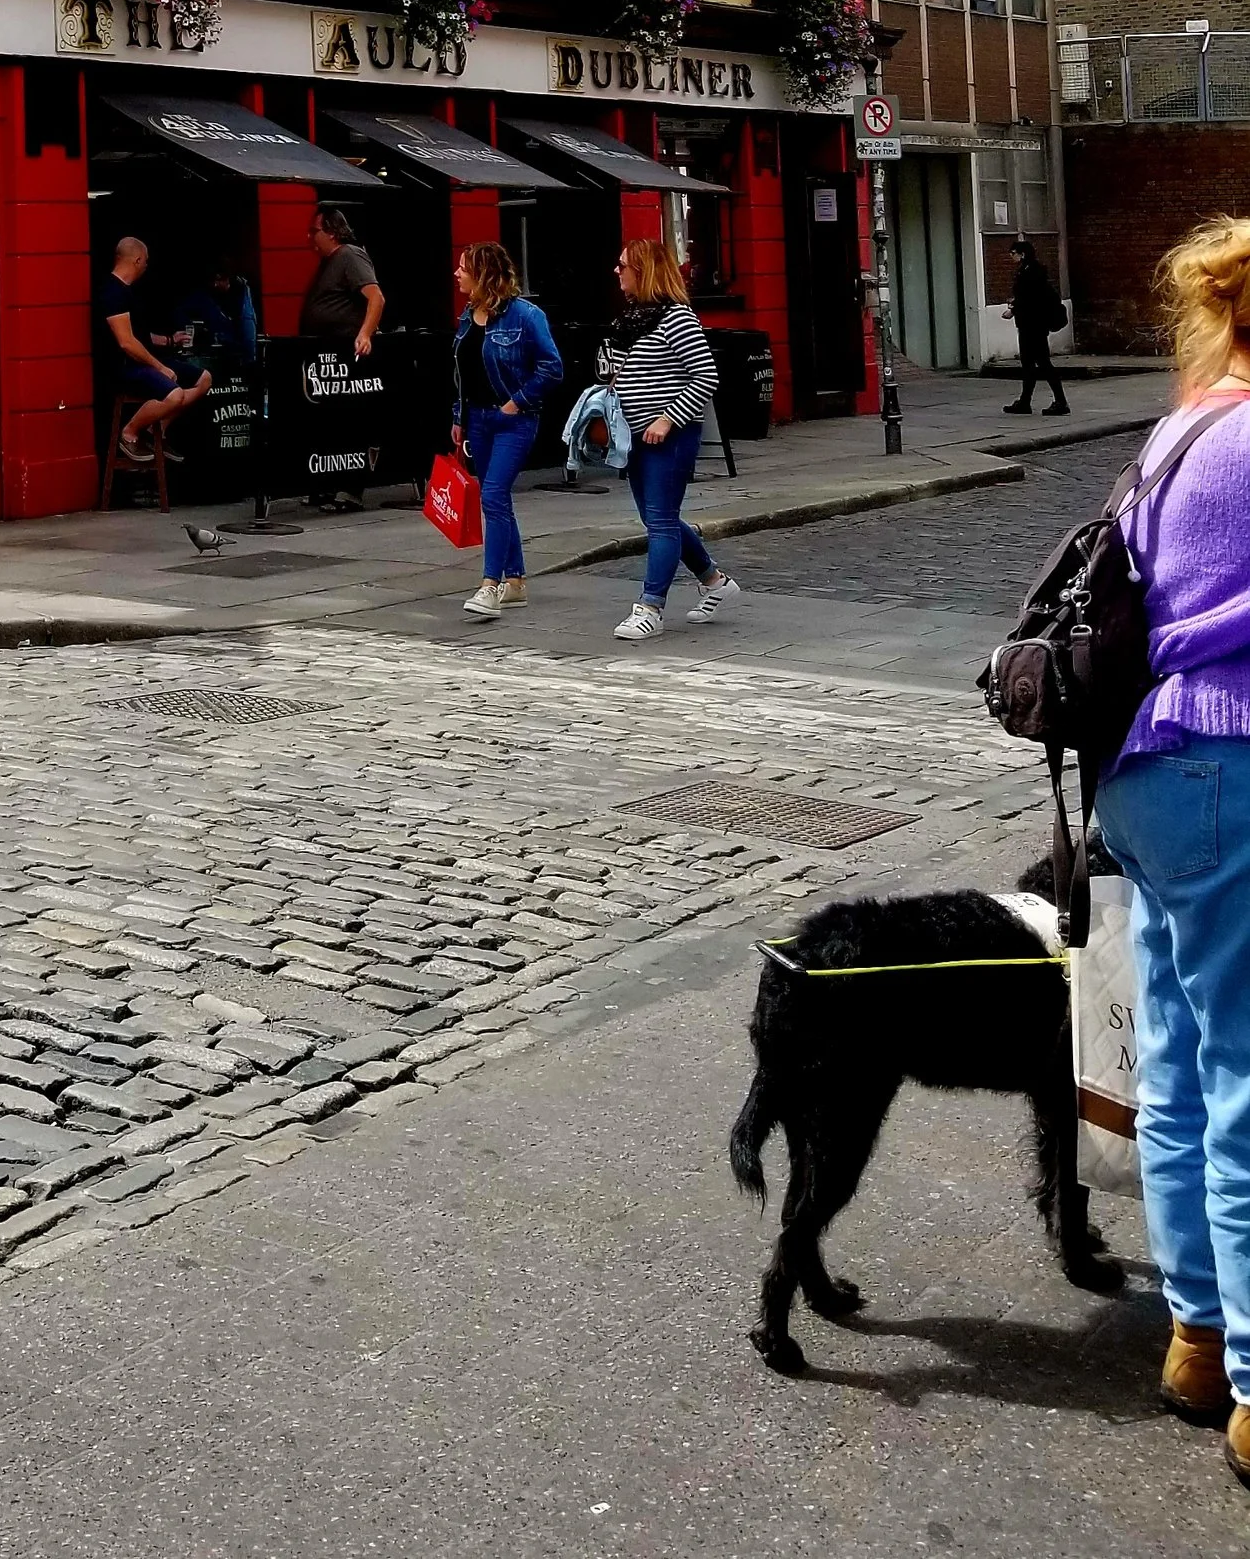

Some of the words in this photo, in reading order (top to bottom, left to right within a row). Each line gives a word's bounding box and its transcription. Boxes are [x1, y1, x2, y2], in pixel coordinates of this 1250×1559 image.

[321, 13, 468, 79] AULD
[557, 44, 755, 99] DUBLINER
[160, 116, 230, 132] AULD
[178, 126, 301, 144] DUBLINER
[318, 353, 338, 363] THE
[307, 362, 349, 380] AULD
[206, 387, 230, 395] AULD
[310, 376, 384, 396] DUBLINER
[308, 452, 366, 474] GUINNESS
